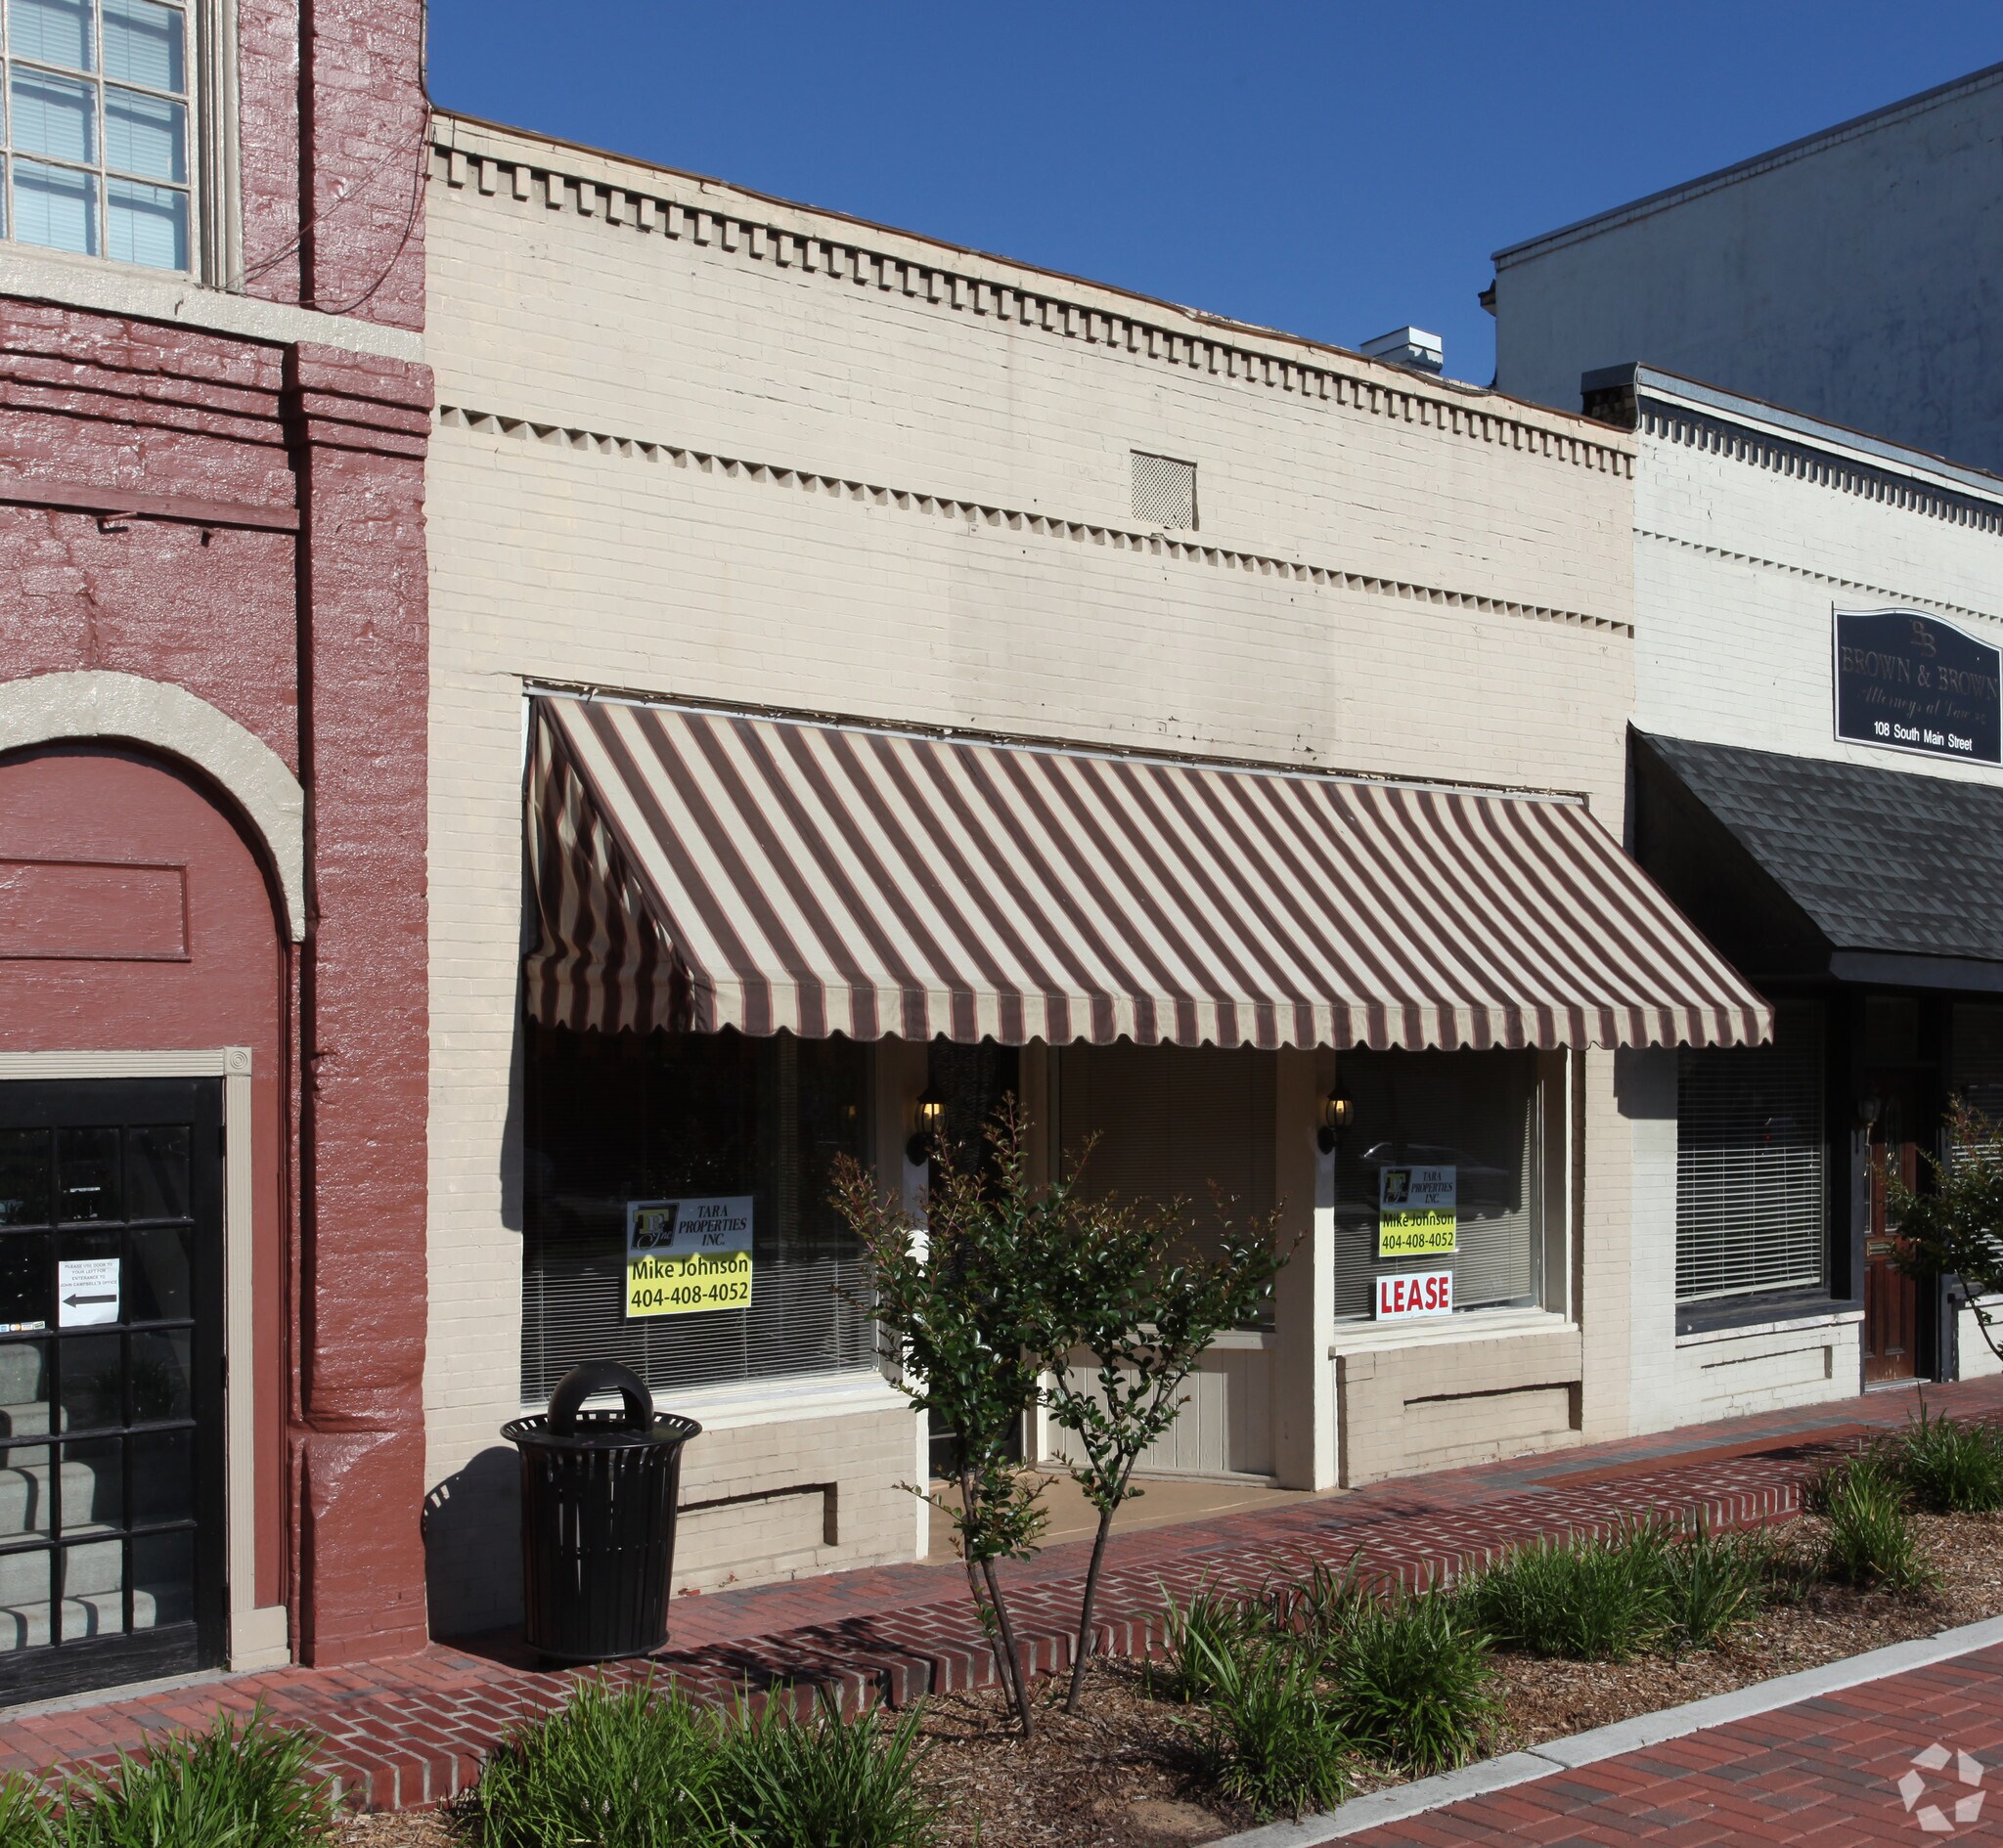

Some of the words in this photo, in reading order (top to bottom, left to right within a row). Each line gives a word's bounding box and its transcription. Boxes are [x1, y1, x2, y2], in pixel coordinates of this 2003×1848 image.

[1841, 645, 1910, 683] BROWN
[1917, 664, 1931, 687] &
[1937, 665, 1998, 700] BROWN
[1926, 699, 1941, 717] at
[1874, 721, 1890, 736] 108
[1893, 724, 1920, 741] South
[1923, 728, 1944, 746] Main
[1948, 734, 1973, 751] Street
[1423, 1171, 1442, 1181] TARA
[1410, 1181, 1452, 1193] PROPERTIES
[1424, 1193, 1440, 1204] INC.
[697, 1204, 728, 1218] TARA
[679, 1217, 747, 1234] PROPERTIES
[1383, 1212, 1408, 1228] Mike
[1410, 1212, 1453, 1227] Johnson
[701, 1233, 726, 1247] INC.
[1382, 1232, 1453, 1250] 404-408-4052
[632, 1259, 675, 1281] Mike
[679, 1256, 748, 1278] Johnson
[631, 1282, 748, 1308] 404-408-4052
[1381, 1276, 1448, 1314] LEASE
